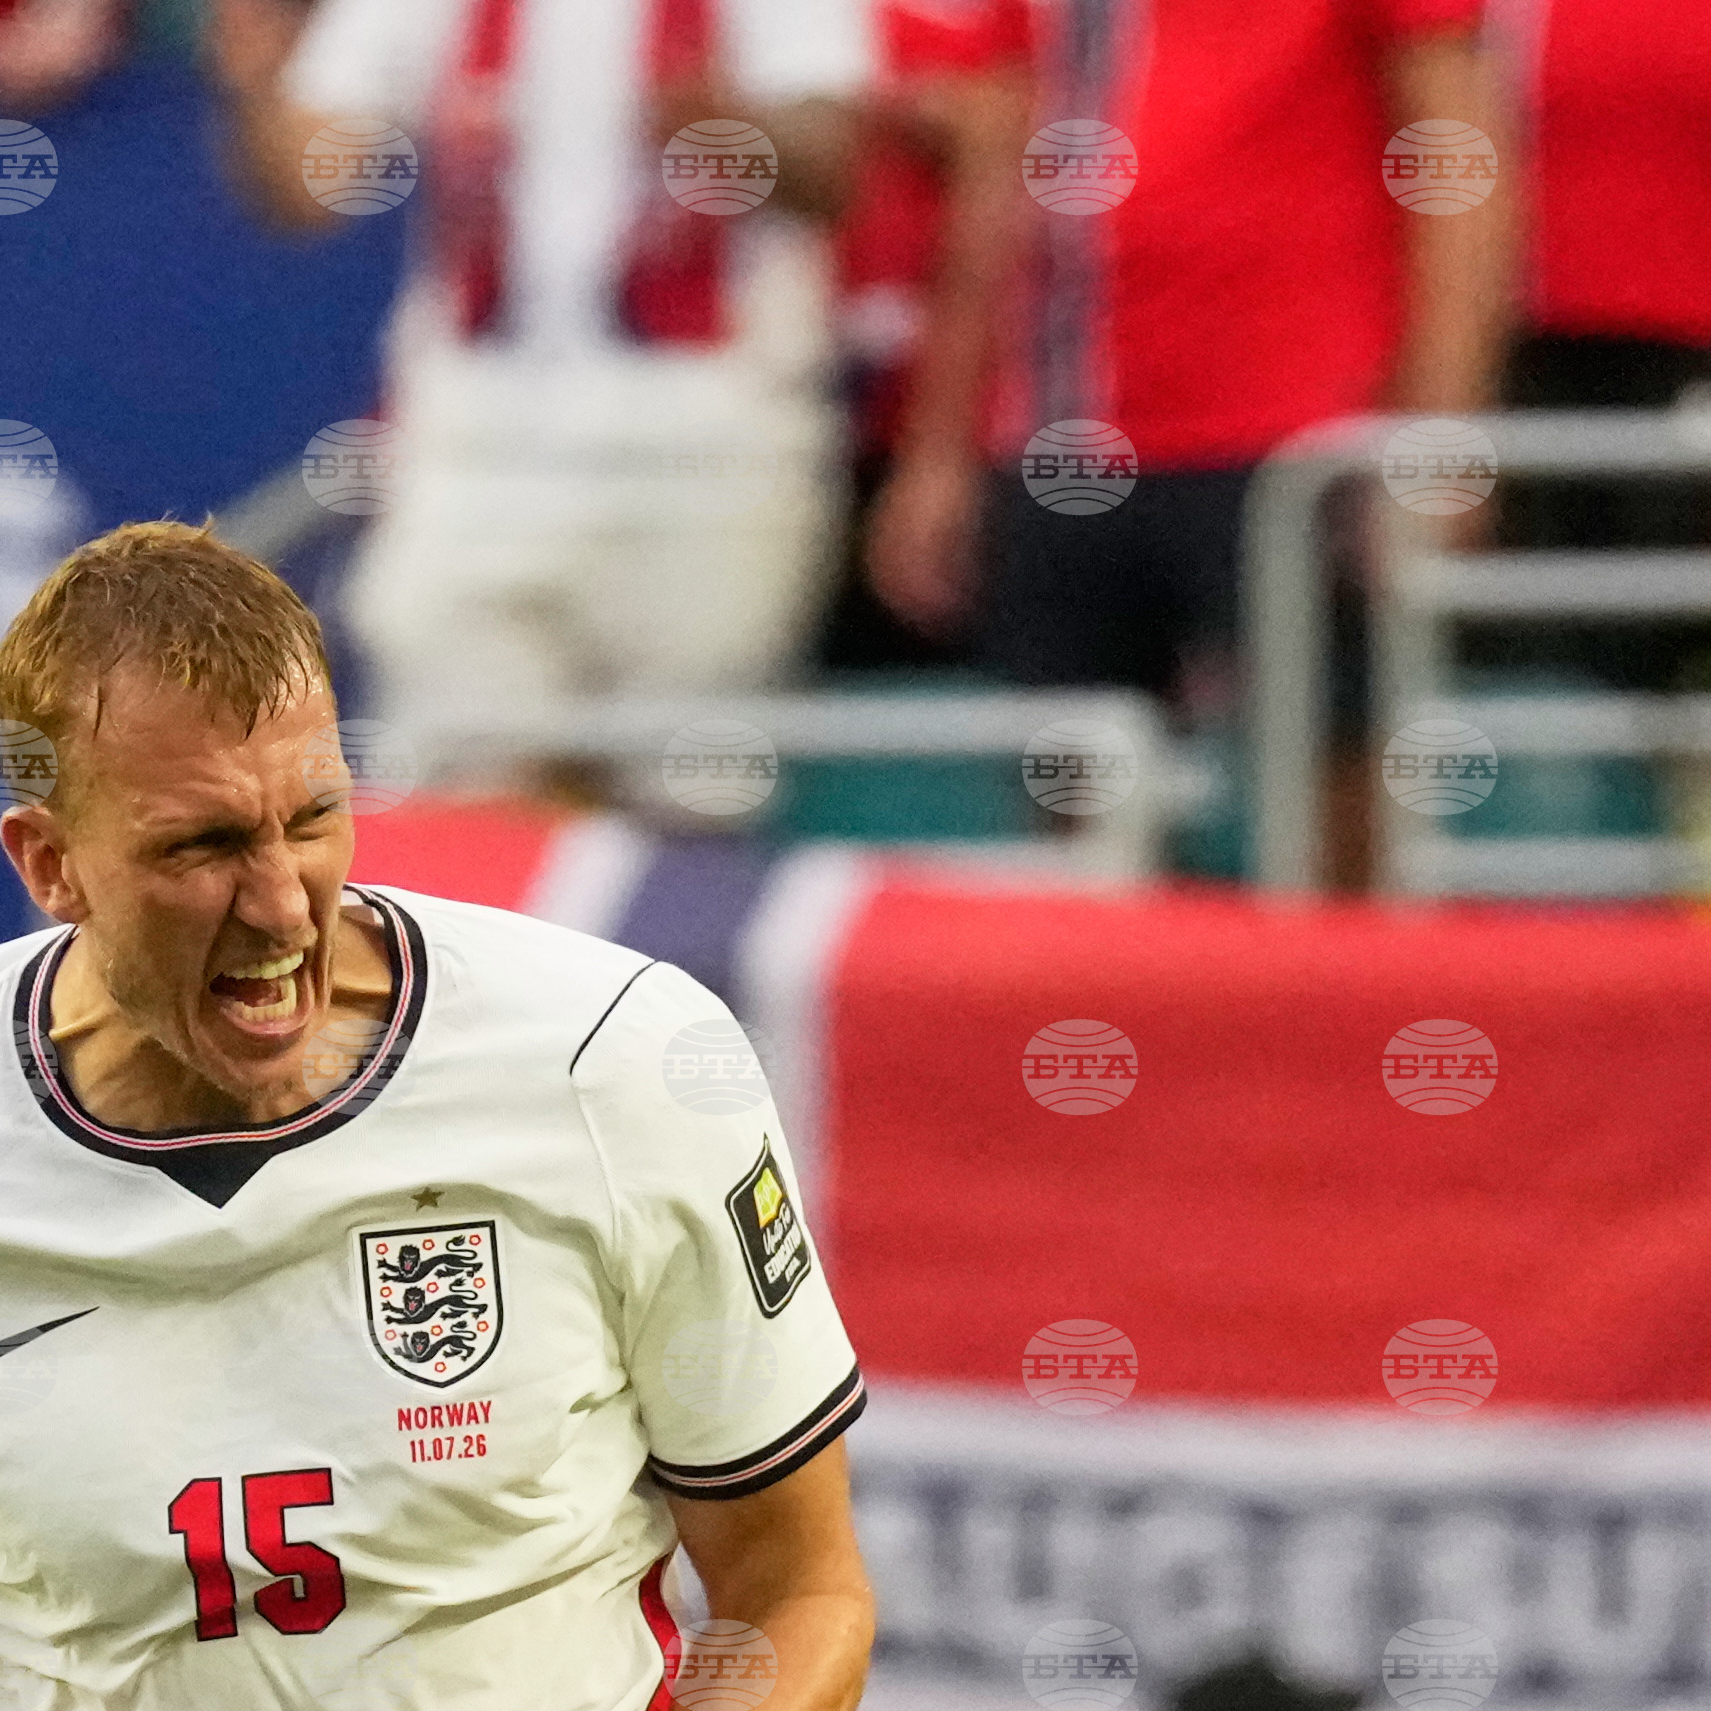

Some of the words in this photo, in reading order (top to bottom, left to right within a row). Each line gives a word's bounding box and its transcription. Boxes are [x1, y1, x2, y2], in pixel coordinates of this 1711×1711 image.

[397, 1400, 493, 1431] NORWAY
[409, 1434, 487, 1463] 11.07.26
[169, 1467, 348, 1643] 15
